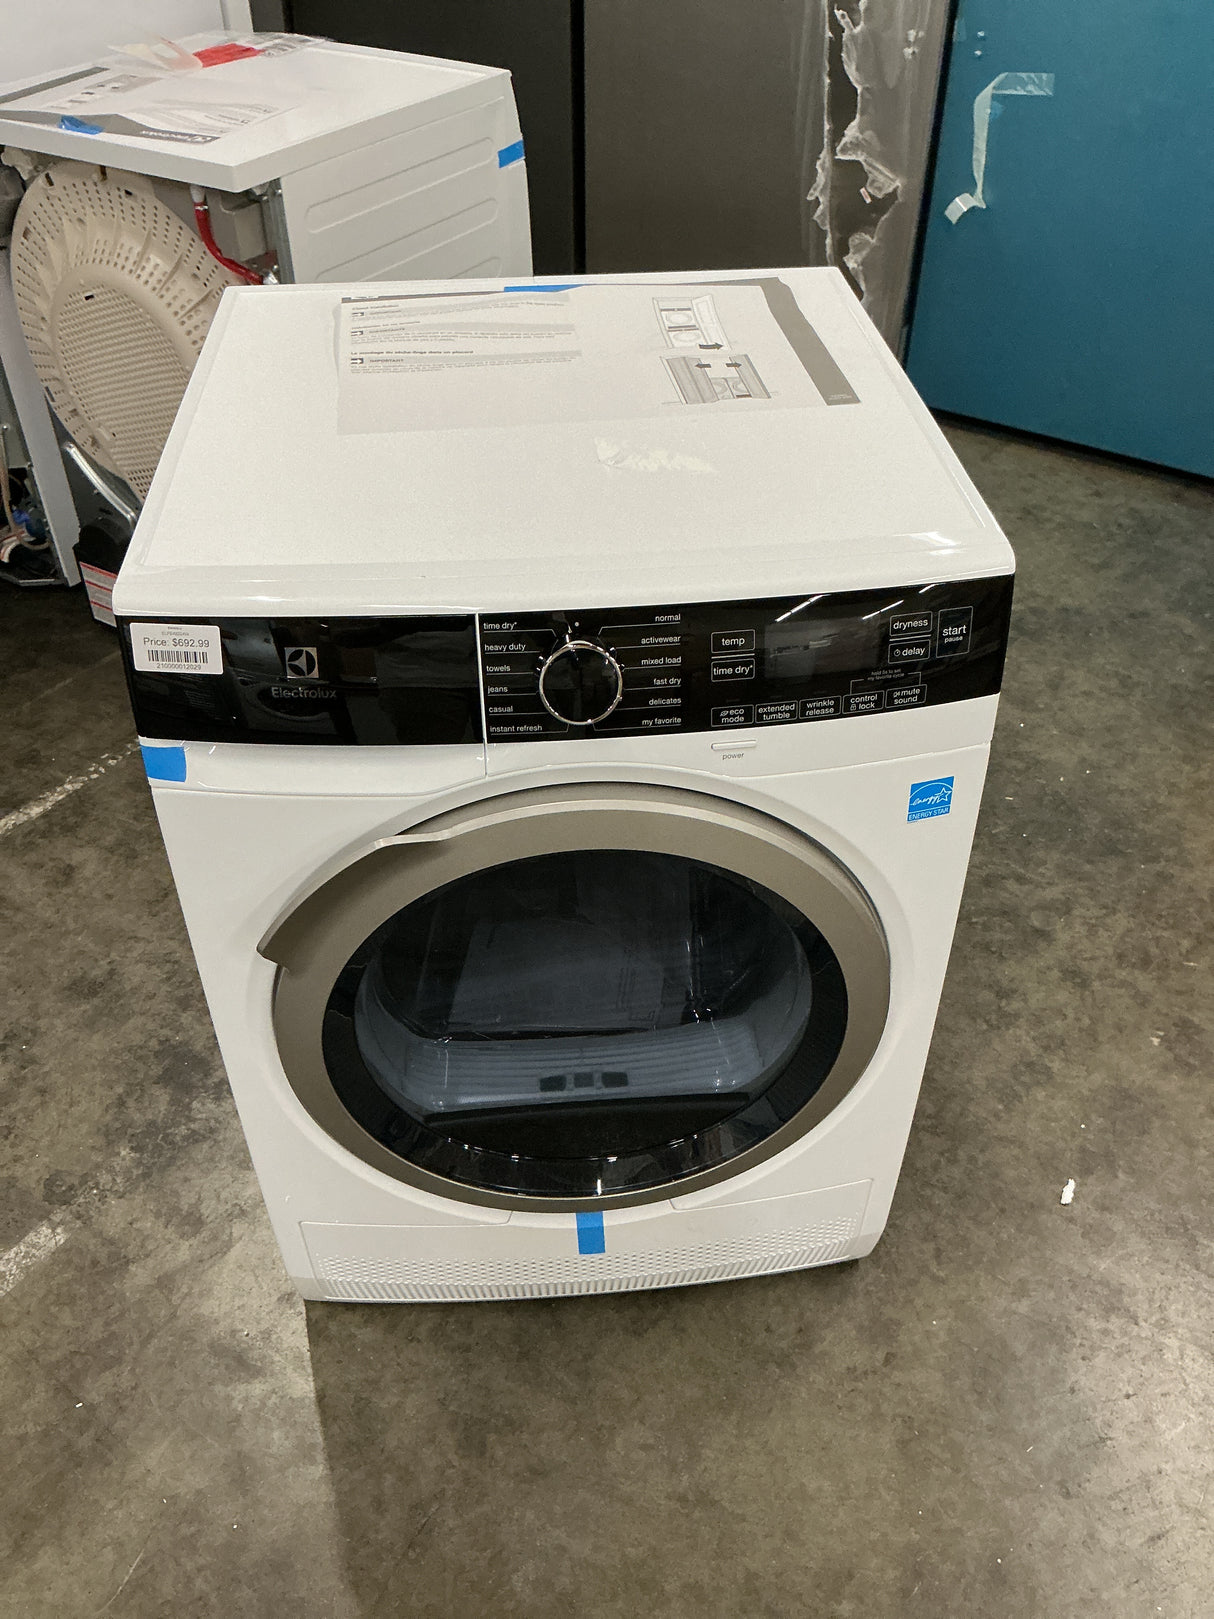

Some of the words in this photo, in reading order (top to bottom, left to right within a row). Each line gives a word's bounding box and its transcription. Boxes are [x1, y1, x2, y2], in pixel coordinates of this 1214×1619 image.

[655, 613, 681, 622] normal
[483, 622, 500, 630] time
[893, 619, 928, 631] dryness
[942, 625, 967, 637] start
[143, 637, 170, 647] Price:
[172, 638, 210, 648] $692.99
[641, 636, 681, 644] activewear
[722, 637, 745, 646] temp
[944, 636, 963, 644] pause
[484, 644, 507, 653] heavy
[508, 643, 526, 652] duty
[902, 647, 926, 657] delay
[641, 657, 664, 666] mixed
[665, 656, 682, 664] load
[713, 666, 733, 676] time
[669, 677, 682, 686] dry
[271, 687, 337, 698] Electrolux
[487, 686, 508, 694] jeans
[901, 687, 921, 696] mute
[648, 697, 682, 706] delicates
[850, 694, 878, 704] control
[894, 695, 918, 705] sound
[806, 700, 835, 708] wrinkle
[859, 702, 876, 710] lock
[758, 704, 795, 714] extended
[805, 707, 835, 716] release
[721, 715, 745, 724] mode
[763, 712, 790, 721] tumble
[642, 718, 653, 727] my
[654, 717, 682, 725] favorite
[517, 724, 542, 732] refresh
[722, 752, 745, 760] power
[908, 811, 932, 821] ENERGY
[933, 807, 949, 816] STAR
